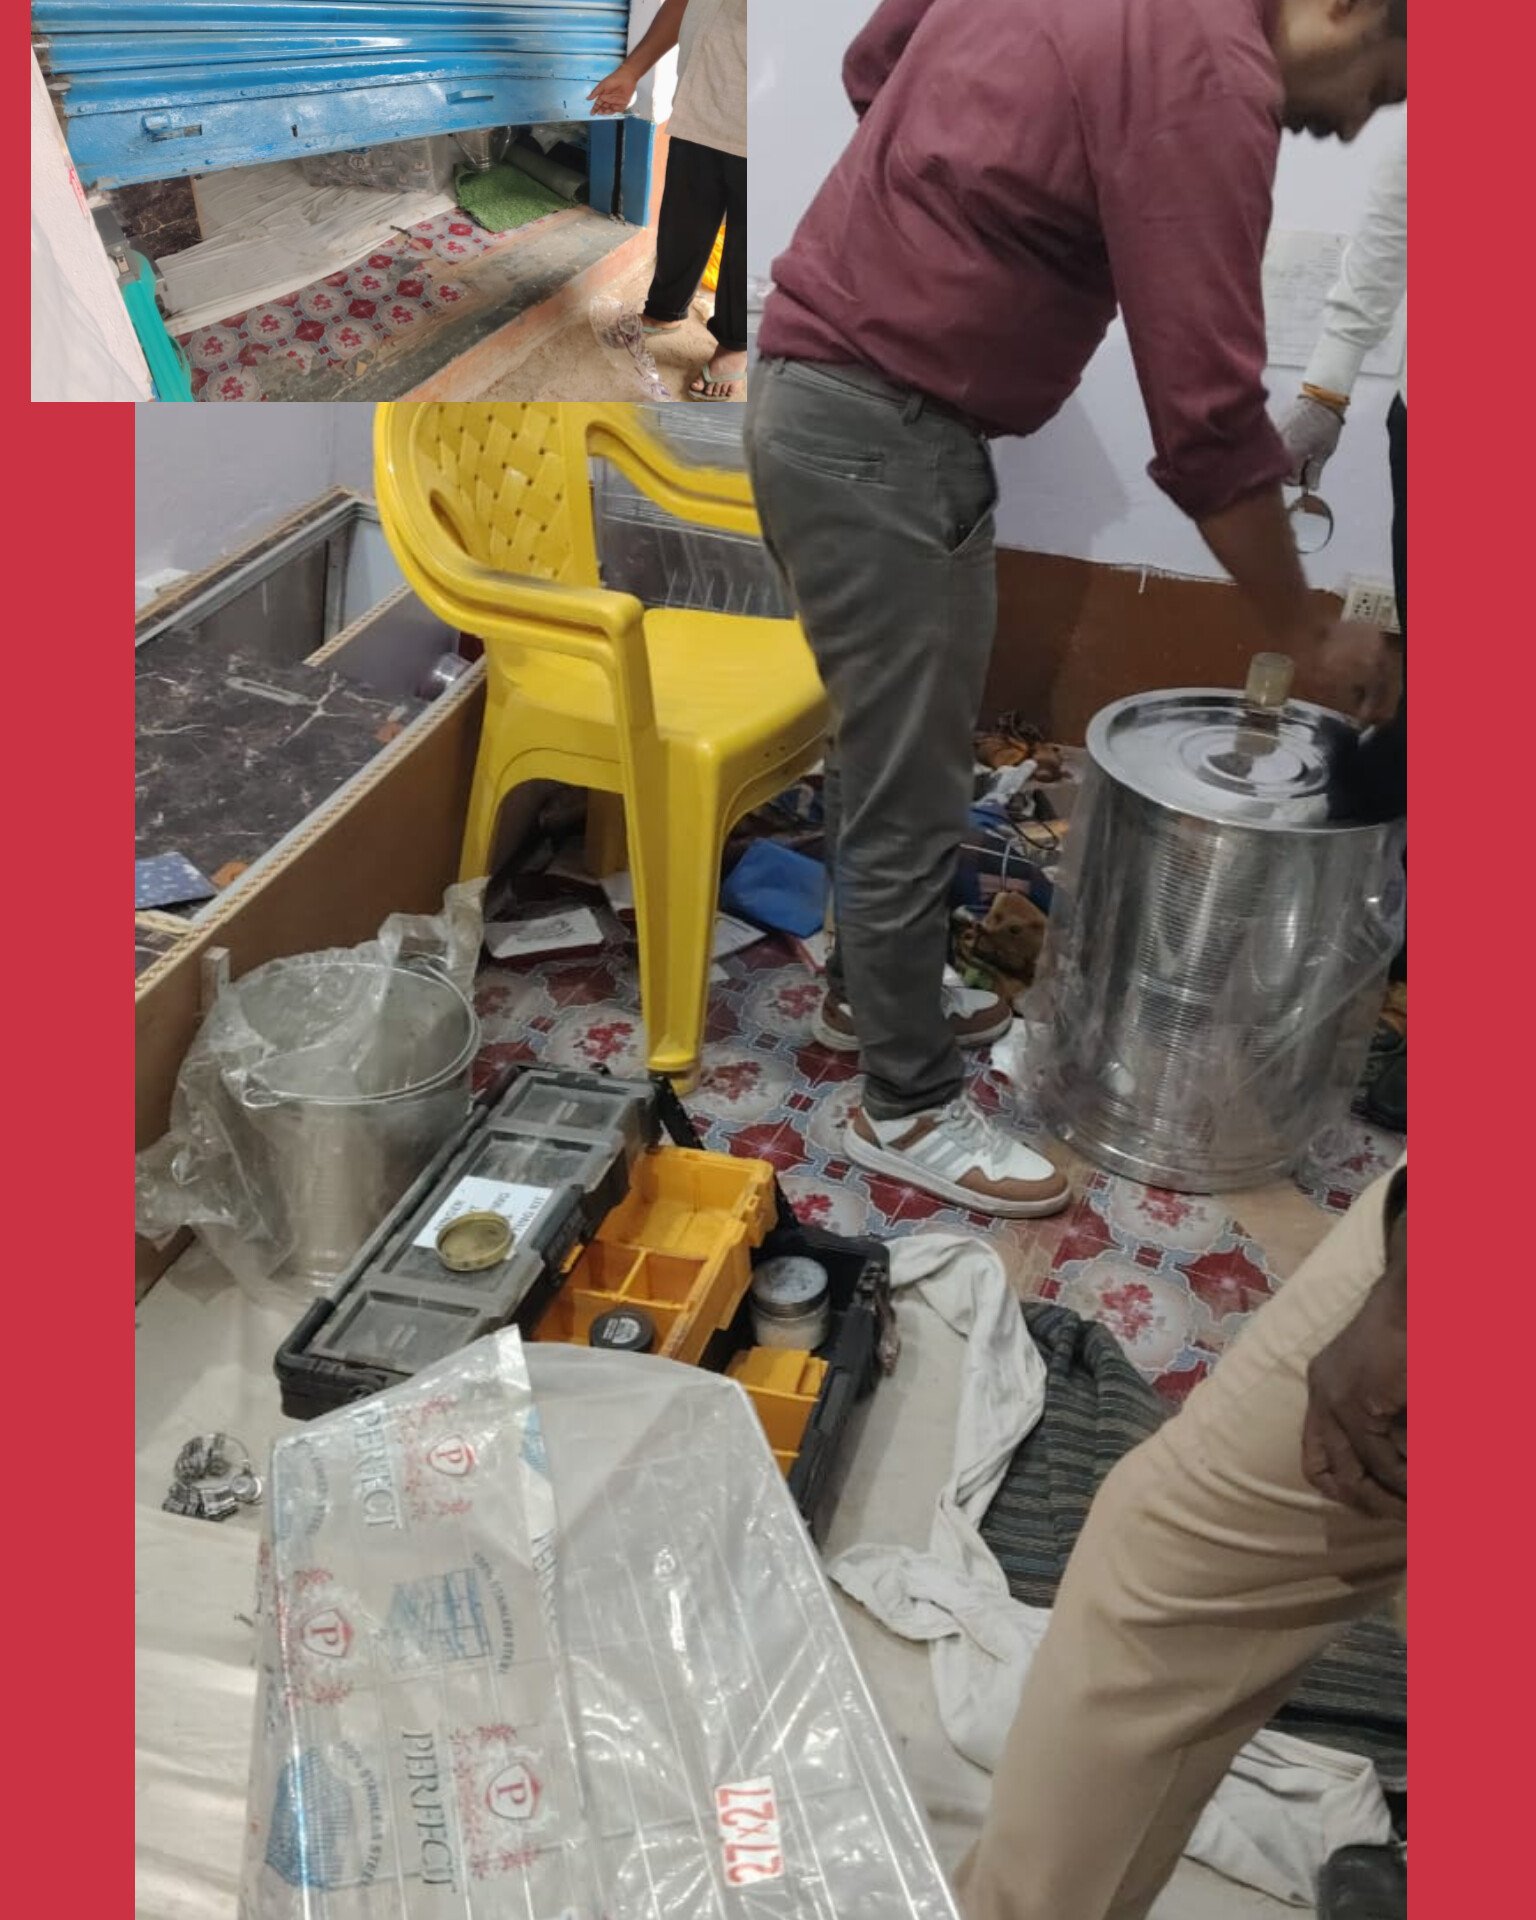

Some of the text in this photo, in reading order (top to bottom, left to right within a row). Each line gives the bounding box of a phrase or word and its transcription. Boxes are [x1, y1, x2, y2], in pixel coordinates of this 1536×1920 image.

[352, 1408, 402, 1532] PERFECT
[311, 1625, 339, 1646] P
[401, 1731, 457, 1893] PERFECT
[496, 1781, 527, 1806] P
